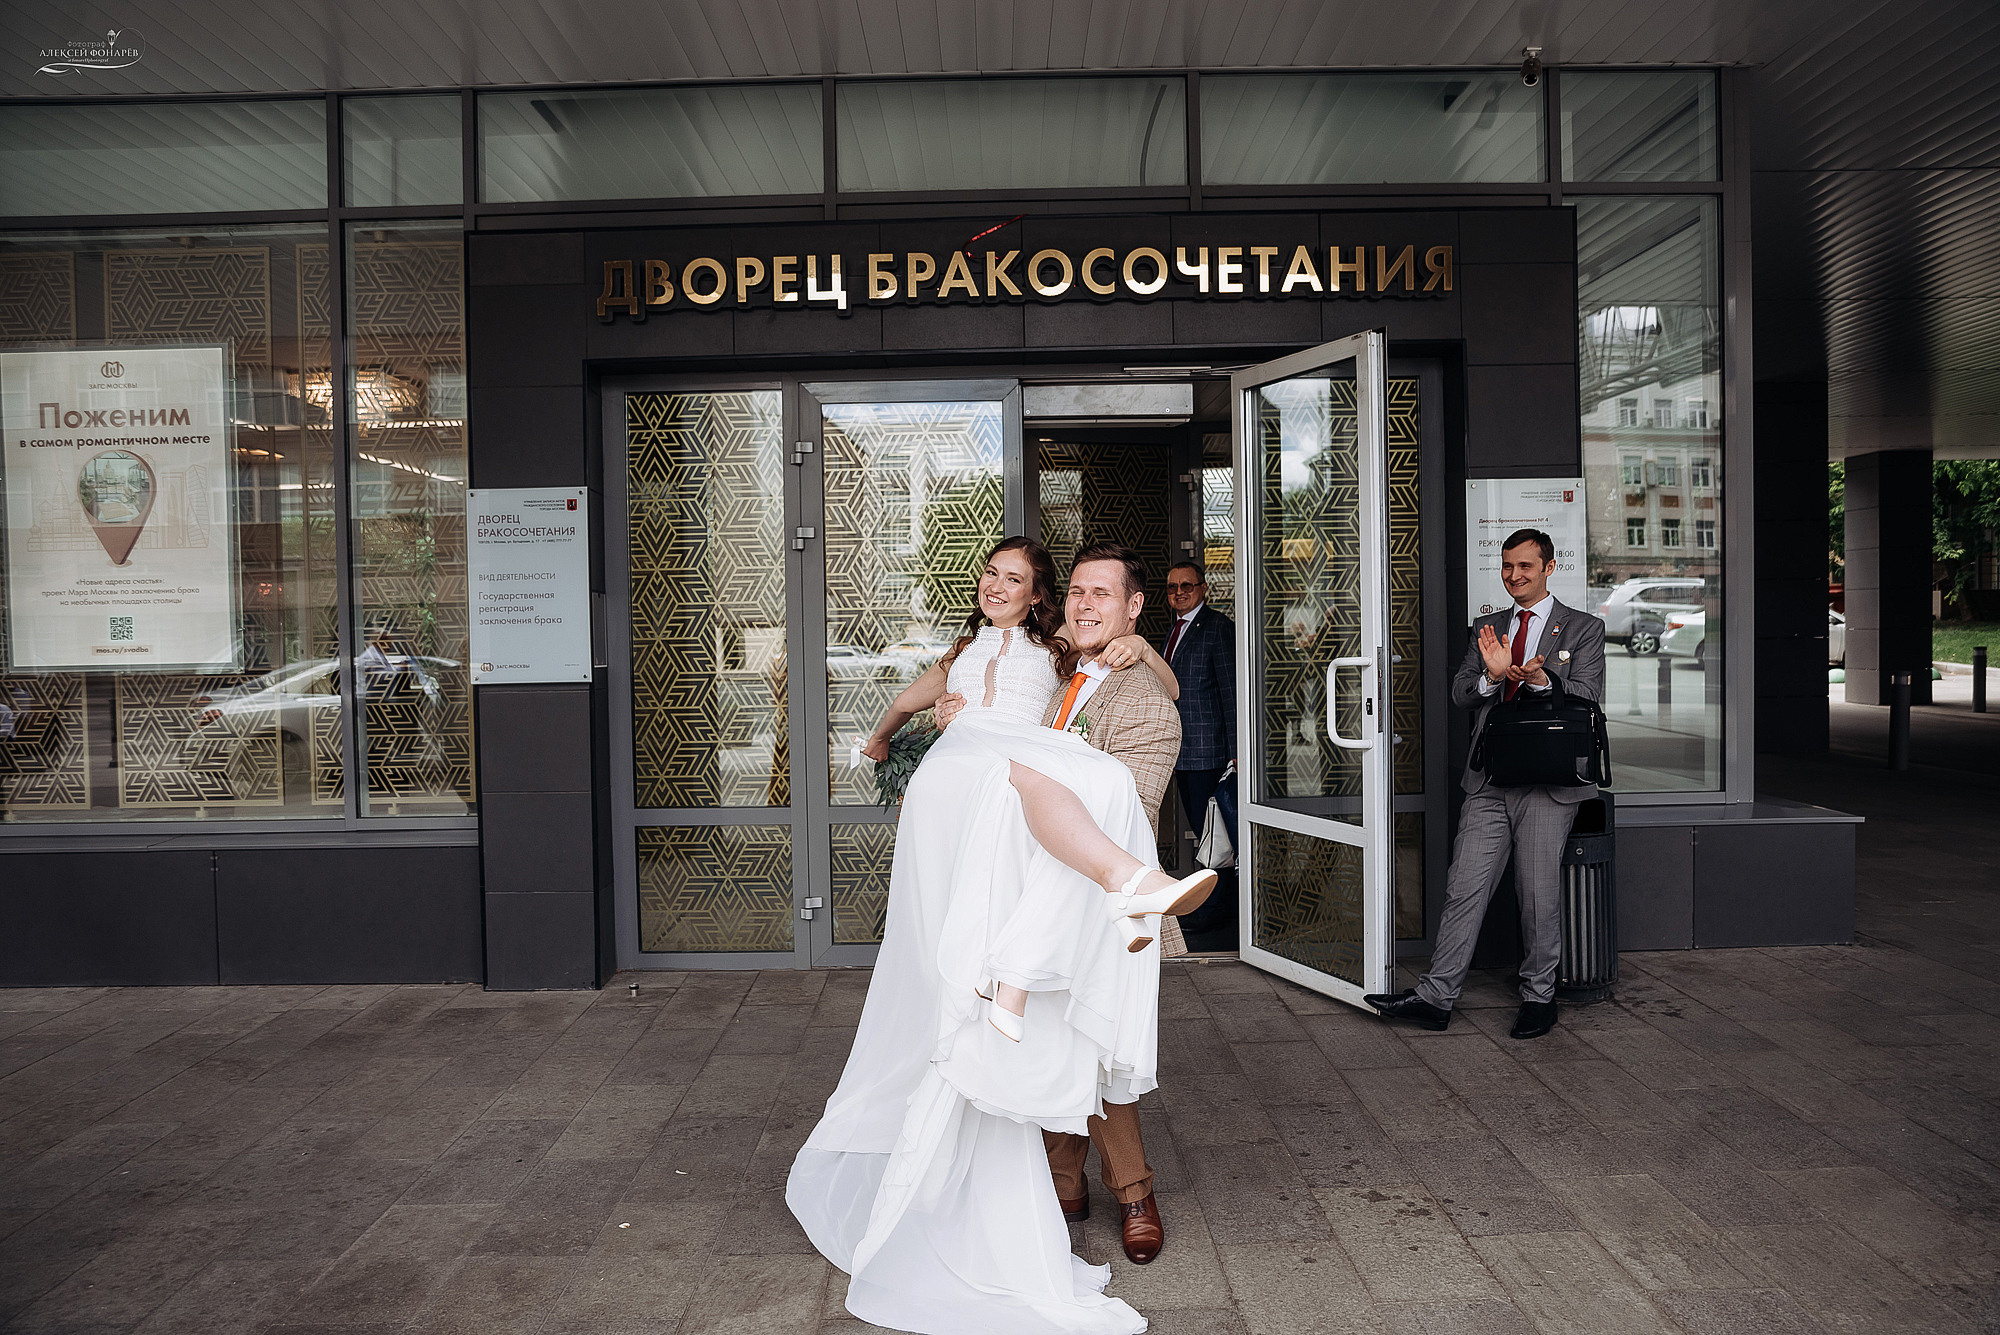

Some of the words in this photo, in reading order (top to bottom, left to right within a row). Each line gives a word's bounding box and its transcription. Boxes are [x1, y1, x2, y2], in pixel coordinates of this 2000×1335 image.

[597, 253, 847, 317] ДВОРЕЦ
[867, 244, 1455, 302] БРАКОСОЧЕТАНИЯ
[89, 382, 105, 391] ЗАГС
[107, 382, 138, 390] МОСКВЫ
[39, 402, 192, 430] Поженим
[20, 438, 27, 448] в
[30, 437, 73, 448] самом
[76, 435, 170, 450] романтичном
[172, 434, 211, 446] месте
[478, 514, 521, 526] ДВОРЕЦ
[478, 527, 576, 538] БРАКОСОЧЕТАНИЯ
[1555, 550, 1575, 558] 18:00
[478, 573, 495, 581] ВИД
[496, 572, 556, 581] ДЕЯТЕЛЬНОСТИ
[104, 578, 131, 588] адреса
[41, 590, 66, 598] проект
[68, 588, 89, 597] Мэра
[90, 588, 119, 596] Москвы
[131, 588, 176, 596] заключению
[177, 586, 200, 595] брака
[478, 591, 555, 602] Государственная
[70, 598, 111, 606] необычных
[111, 598, 152, 606] площадках
[153, 597, 183, 606] столицы
[478, 604, 535, 615] регистрация
[479, 617, 532, 626] заключения
[534, 615, 563, 626] брака
[96, 646, 150, 655] mos.ru/svadba
